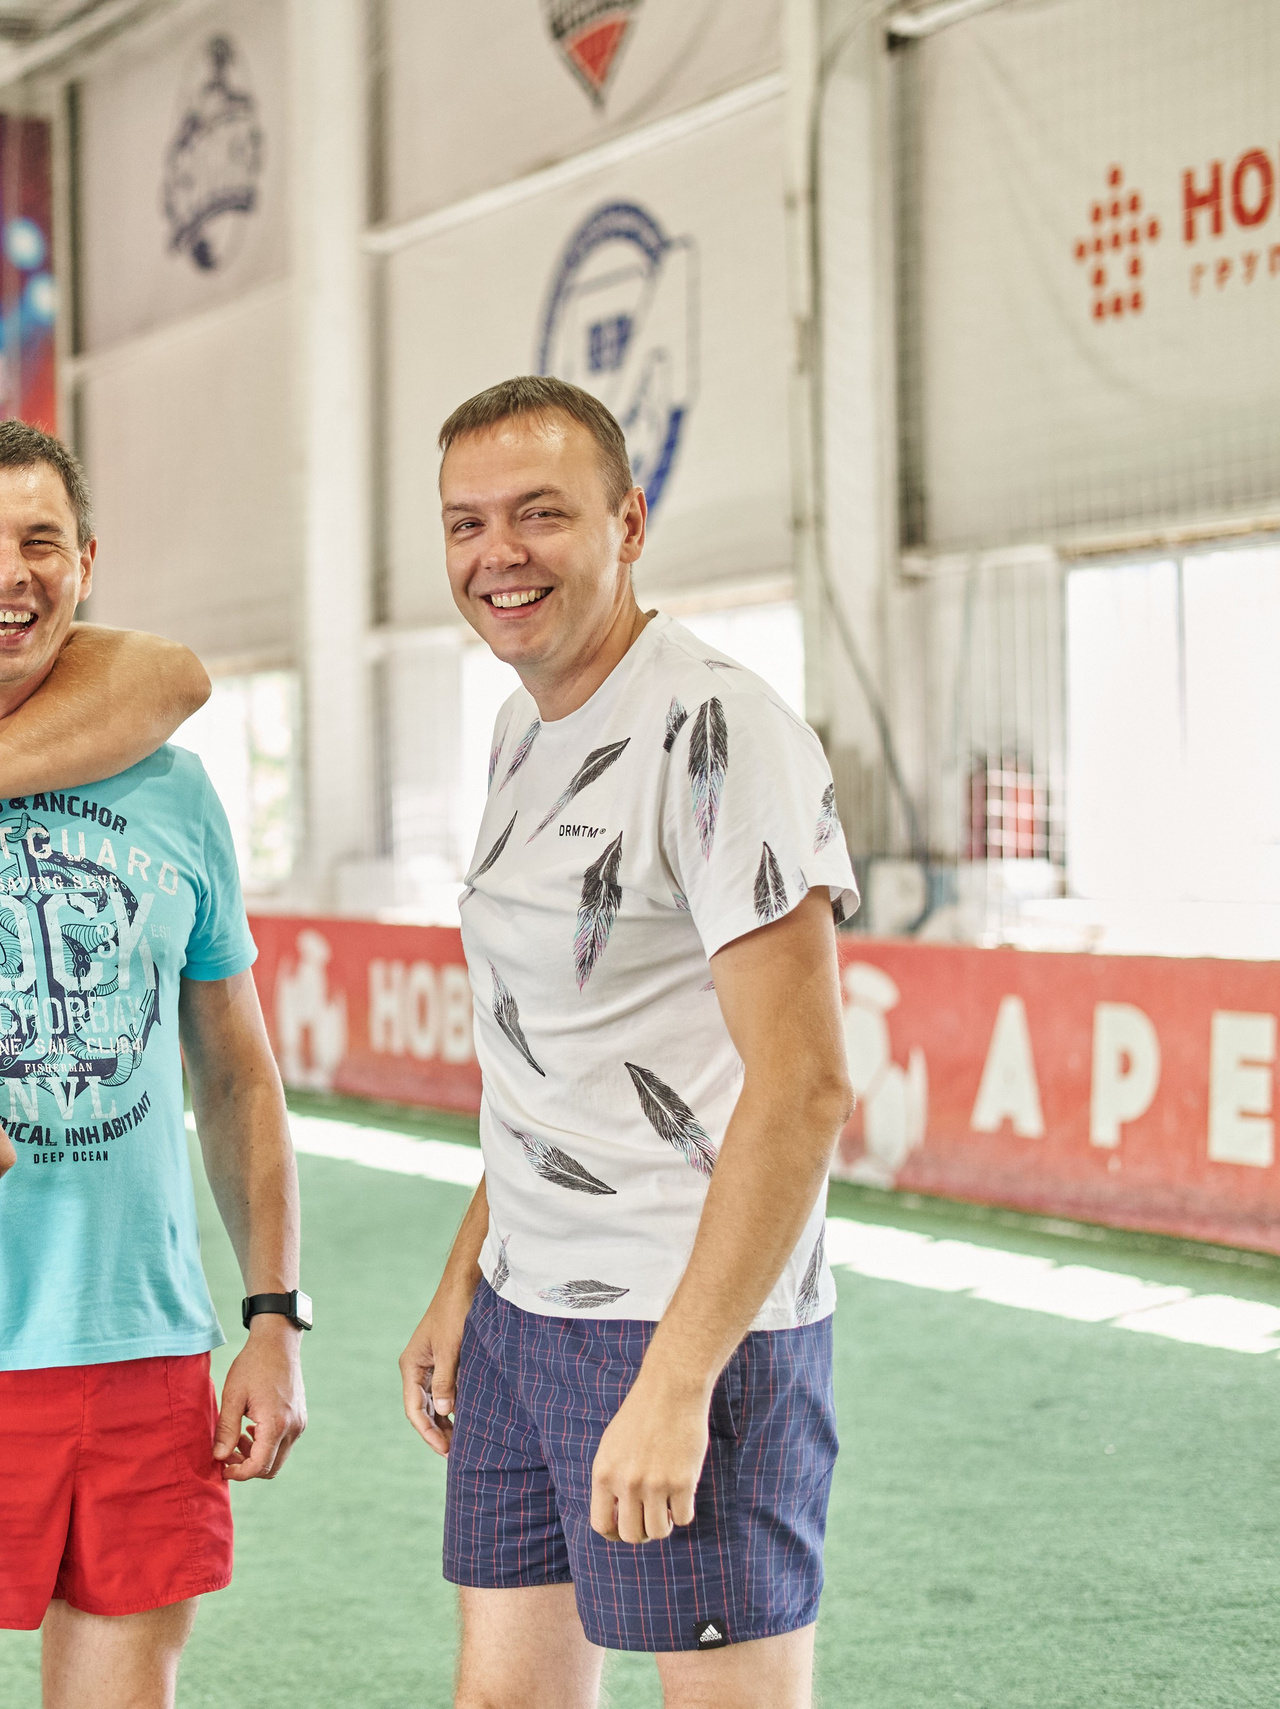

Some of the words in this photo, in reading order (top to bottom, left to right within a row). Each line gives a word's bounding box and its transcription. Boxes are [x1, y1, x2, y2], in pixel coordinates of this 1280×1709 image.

[1180, 148, 1280, 246] НО
[32, 792, 128, 835] ANCHOR
[24, 1062, 93, 1073] FISHERMAN
[35, 1037, 75, 1056] SAIL
[4, 1075, 117, 1123] NVL
[971, 993, 1277, 1168] АРЕ
[65, 1089, 153, 1147] INHABITANT
[33, 1151, 65, 1164] DEEP
[72, 1150, 109, 1162] OCEAN
